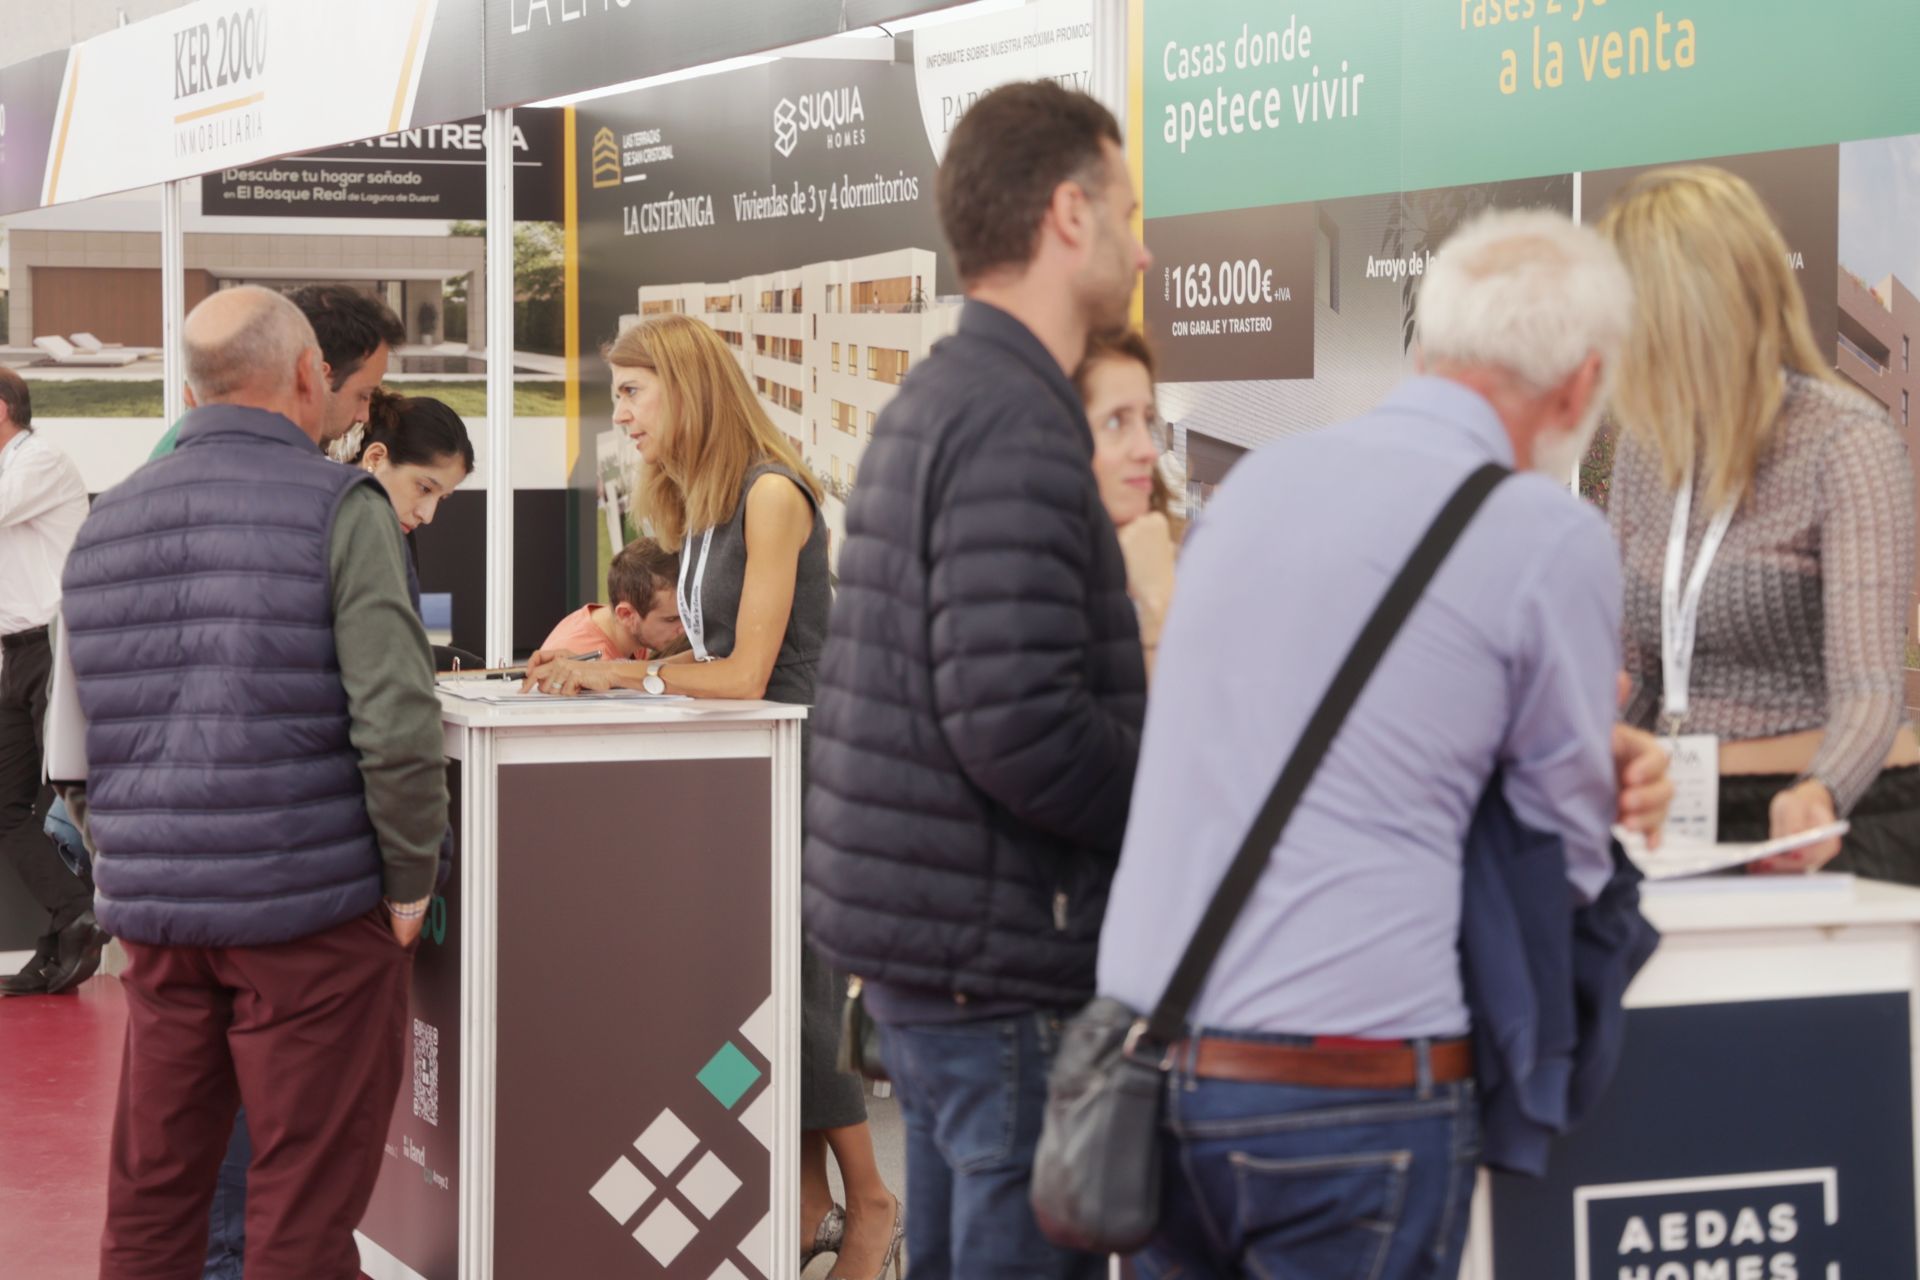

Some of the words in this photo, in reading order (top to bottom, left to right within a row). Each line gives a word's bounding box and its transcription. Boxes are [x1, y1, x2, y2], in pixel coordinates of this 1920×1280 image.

[173, 23, 213, 100] KER
[215, 3, 267, 87] 2000
[966, 44, 989, 61] SOBRE
[990, 37, 1022, 57] NUESTRA
[1056, 22, 1092, 43] PROMOCI
[1164, 41, 1226, 82] Casas
[1234, 14, 1312, 69] donde
[1498, 48, 1517, 95] a
[1532, 25, 1563, 90] la
[1578, 10, 1696, 82] venta
[799, 85, 864, 131] SUQUIA
[1164, 86, 1281, 153] apetece
[1292, 60, 1364, 124] vivir
[174, 111, 263, 158] INMOBILIARIA
[827, 128, 866, 149] HOMES
[221, 168, 299, 184] ¡Descubre
[302, 169, 318, 183] tu
[320, 169, 364, 188] hogar
[367, 170, 422, 185] soñado
[223, 191, 236, 199] en
[237, 185, 251, 199] El
[254, 185, 310, 203] Bosque
[312, 186, 347, 200] Real
[348, 193, 360, 201] de
[361, 193, 395, 204] Laguna
[396, 193, 407, 202] de
[733, 183, 788, 222] Viviendas
[790, 181, 806, 215] de
[808, 184, 816, 213] 3
[818, 189, 827, 222] y
[829, 182, 838, 210] 4
[840, 170, 919, 209] dormitorios
[623, 205, 639, 236] LA
[640, 191, 715, 234] CISTÉRNIGA
[1172, 258, 1272, 309] 163.000€
[1274, 287, 1291, 302] +IVA
[1366, 255, 1407, 282] Arroyo
[1409, 251, 1423, 276] de
[1172, 321, 1188, 336] CON
[1190, 319, 1220, 335] GARAJE
[1221, 319, 1228, 334] Y
[1229, 316, 1272, 333] TRASTERO
[1617, 1203, 1799, 1255] AEDAS
